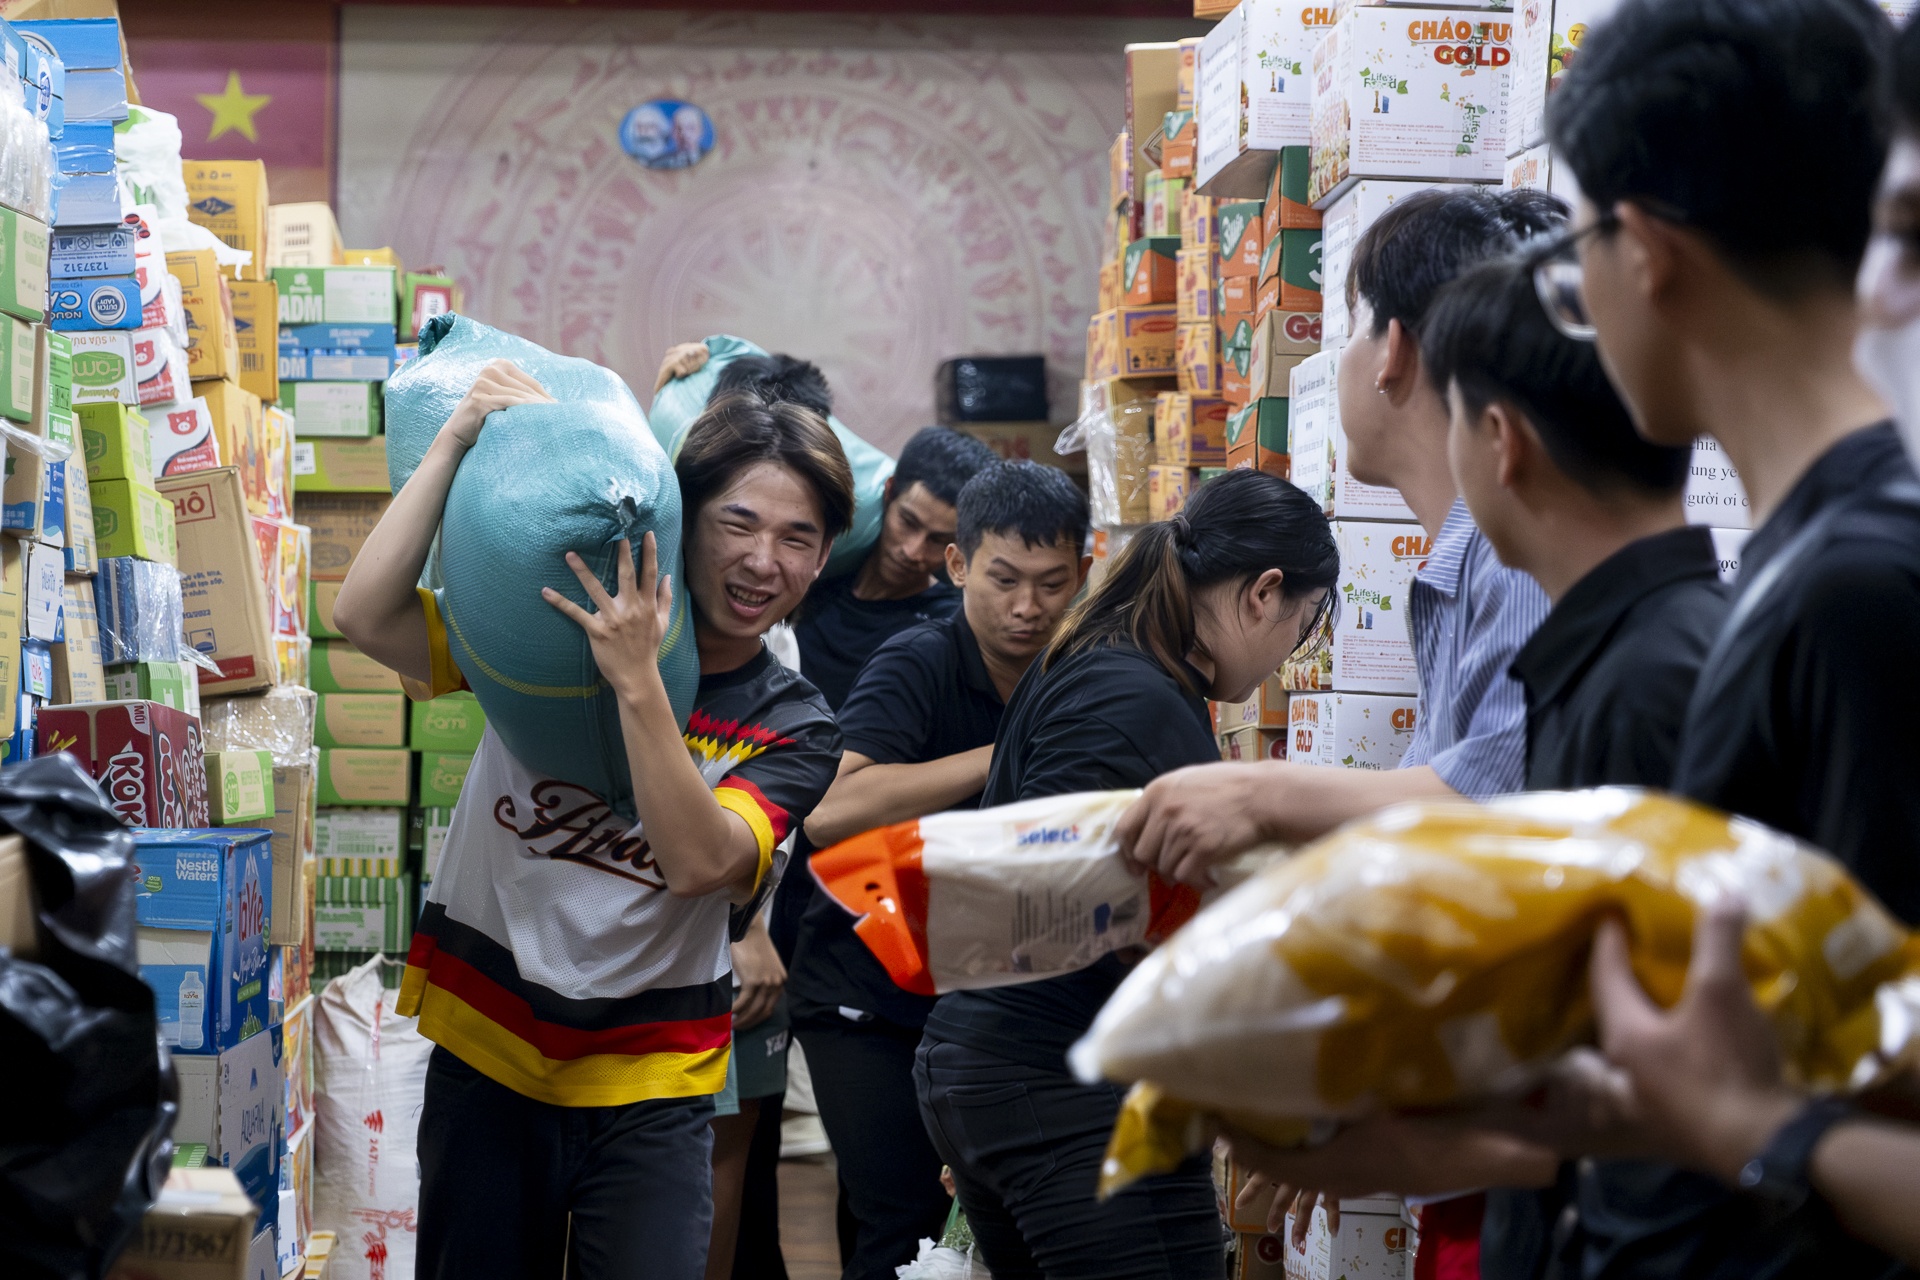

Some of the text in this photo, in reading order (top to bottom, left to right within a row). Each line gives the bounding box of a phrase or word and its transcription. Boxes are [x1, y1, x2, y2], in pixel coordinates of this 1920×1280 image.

[1408, 17, 1513, 42] CHÁO TƯ
[1434, 45, 1511, 67] GOLD
[63, 261, 109, 273] 1237312
[97, 303, 118, 311] DUTCH
[1723, 493, 1737, 506] ơi
[176, 858, 218, 872] Nestlé
[176, 869, 218, 882] Waters
